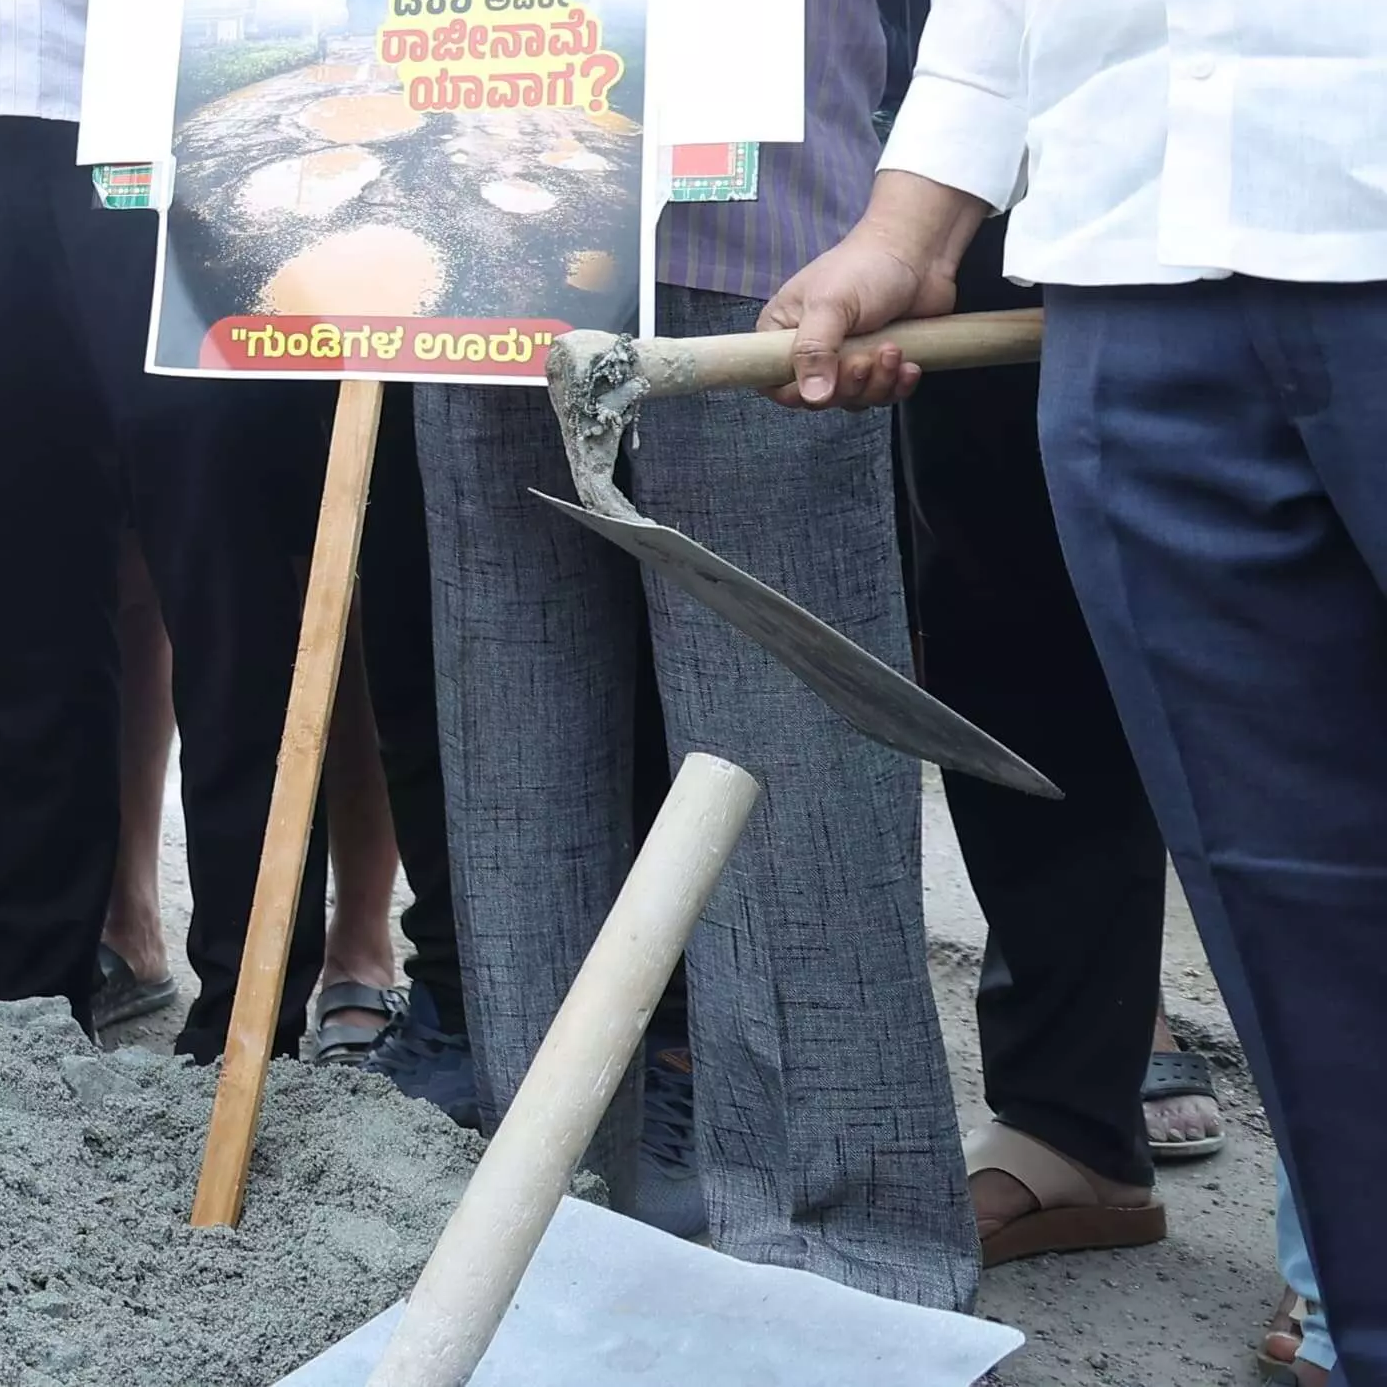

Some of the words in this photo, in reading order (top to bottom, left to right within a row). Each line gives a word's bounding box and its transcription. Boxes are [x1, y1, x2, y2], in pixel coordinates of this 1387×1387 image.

[381, 9, 597, 63] ರಾಜೀನಾಮೆ
[409, 54, 620, 112] ಯಾವಾಗ?
[232, 323, 404, 359] "ಗುಂಡಿಗಳ
